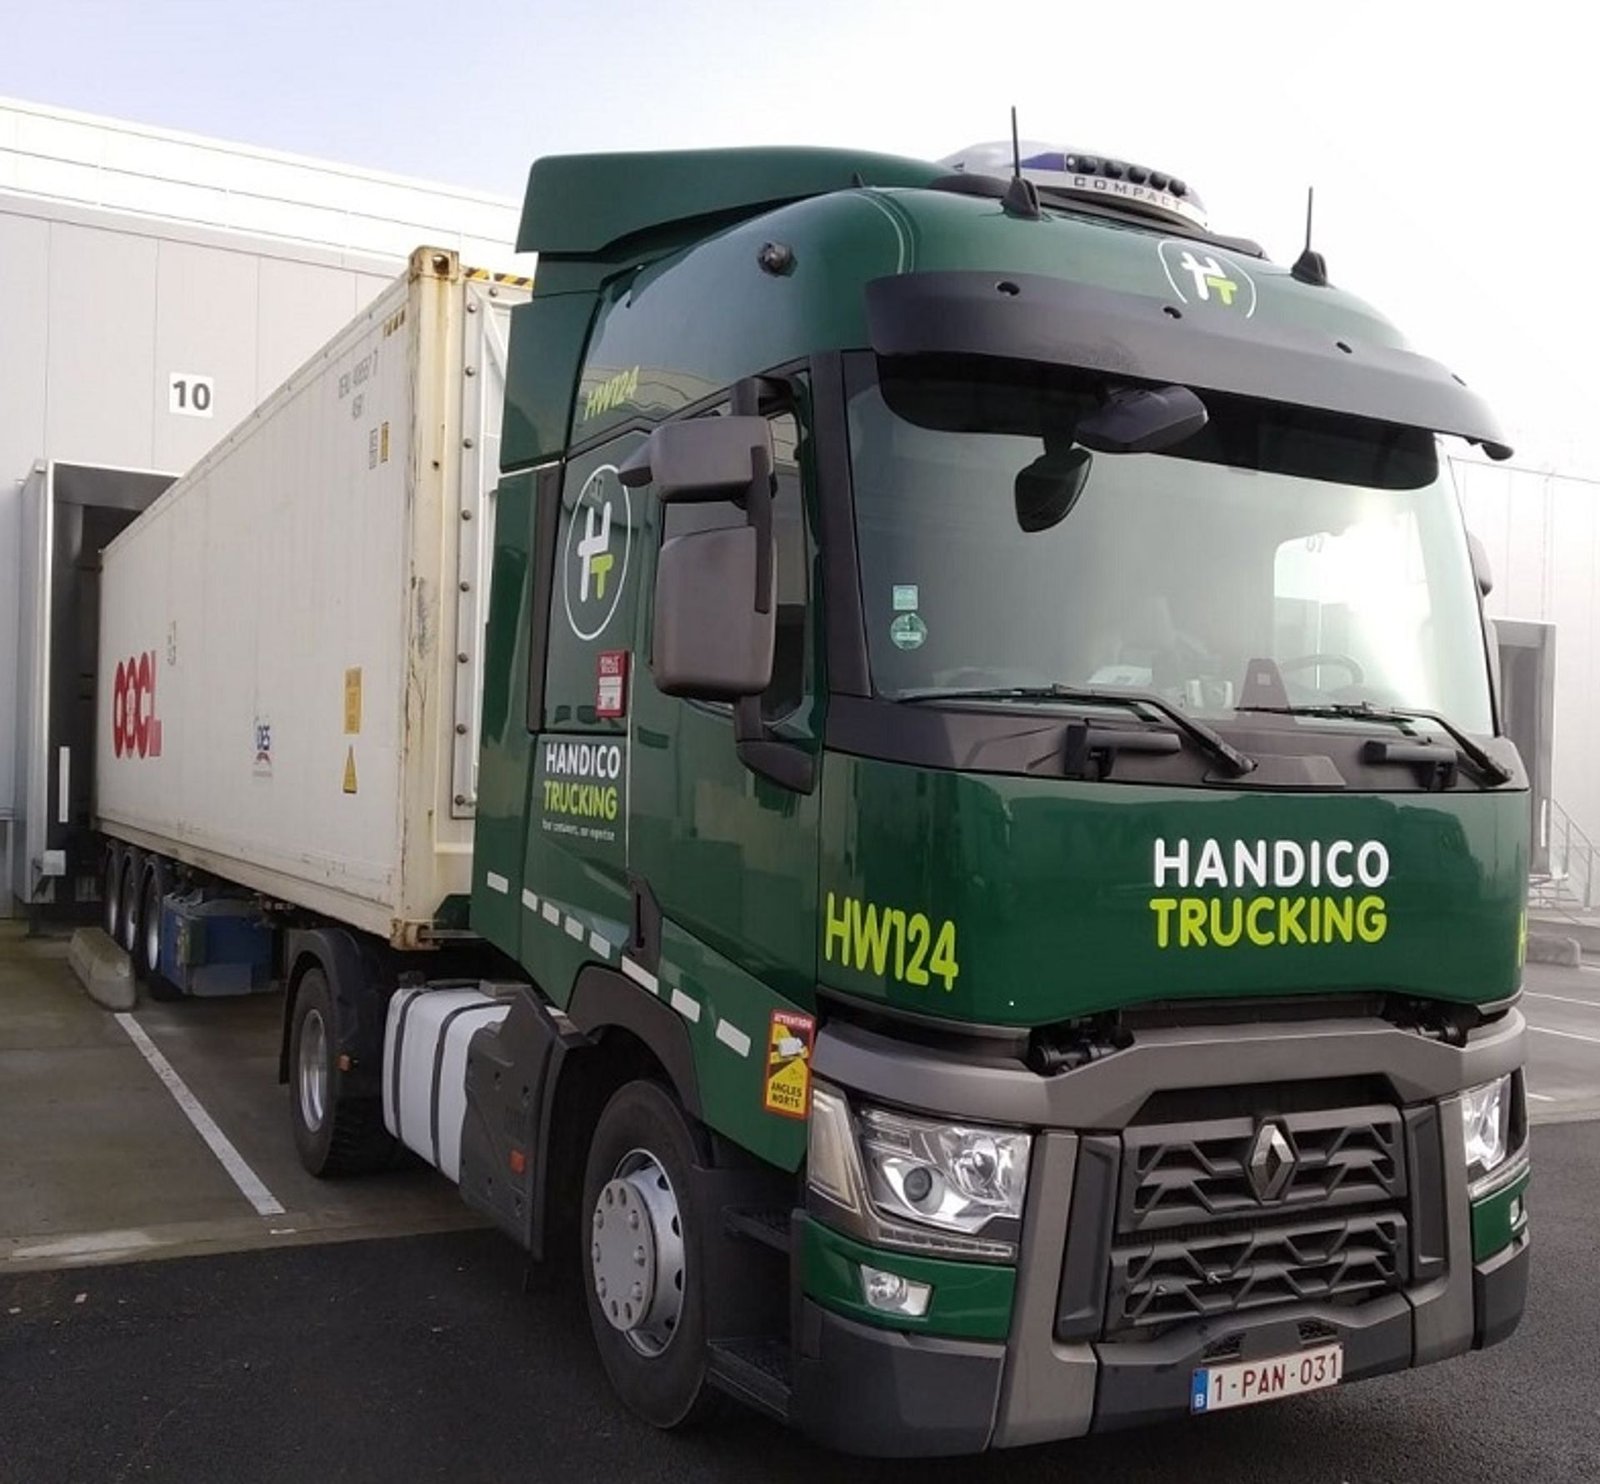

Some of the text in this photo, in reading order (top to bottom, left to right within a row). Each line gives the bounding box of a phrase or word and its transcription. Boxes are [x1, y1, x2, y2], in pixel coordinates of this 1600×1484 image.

[1074, 175, 1183, 209] COMPACT
[173, 380, 211, 411] 10
[584, 365, 640, 421] HW124
[113, 650, 161, 760] OOCL
[545, 743, 621, 780] HANDICO
[543, 780, 618, 821] TRUCKING
[1153, 838, 1390, 888] HANDICO
[825, 892, 959, 991] HW124
[1149, 895, 1388, 948] TRUCKING
[1194, 1352, 1337, 1408] B 1-PAN-031
